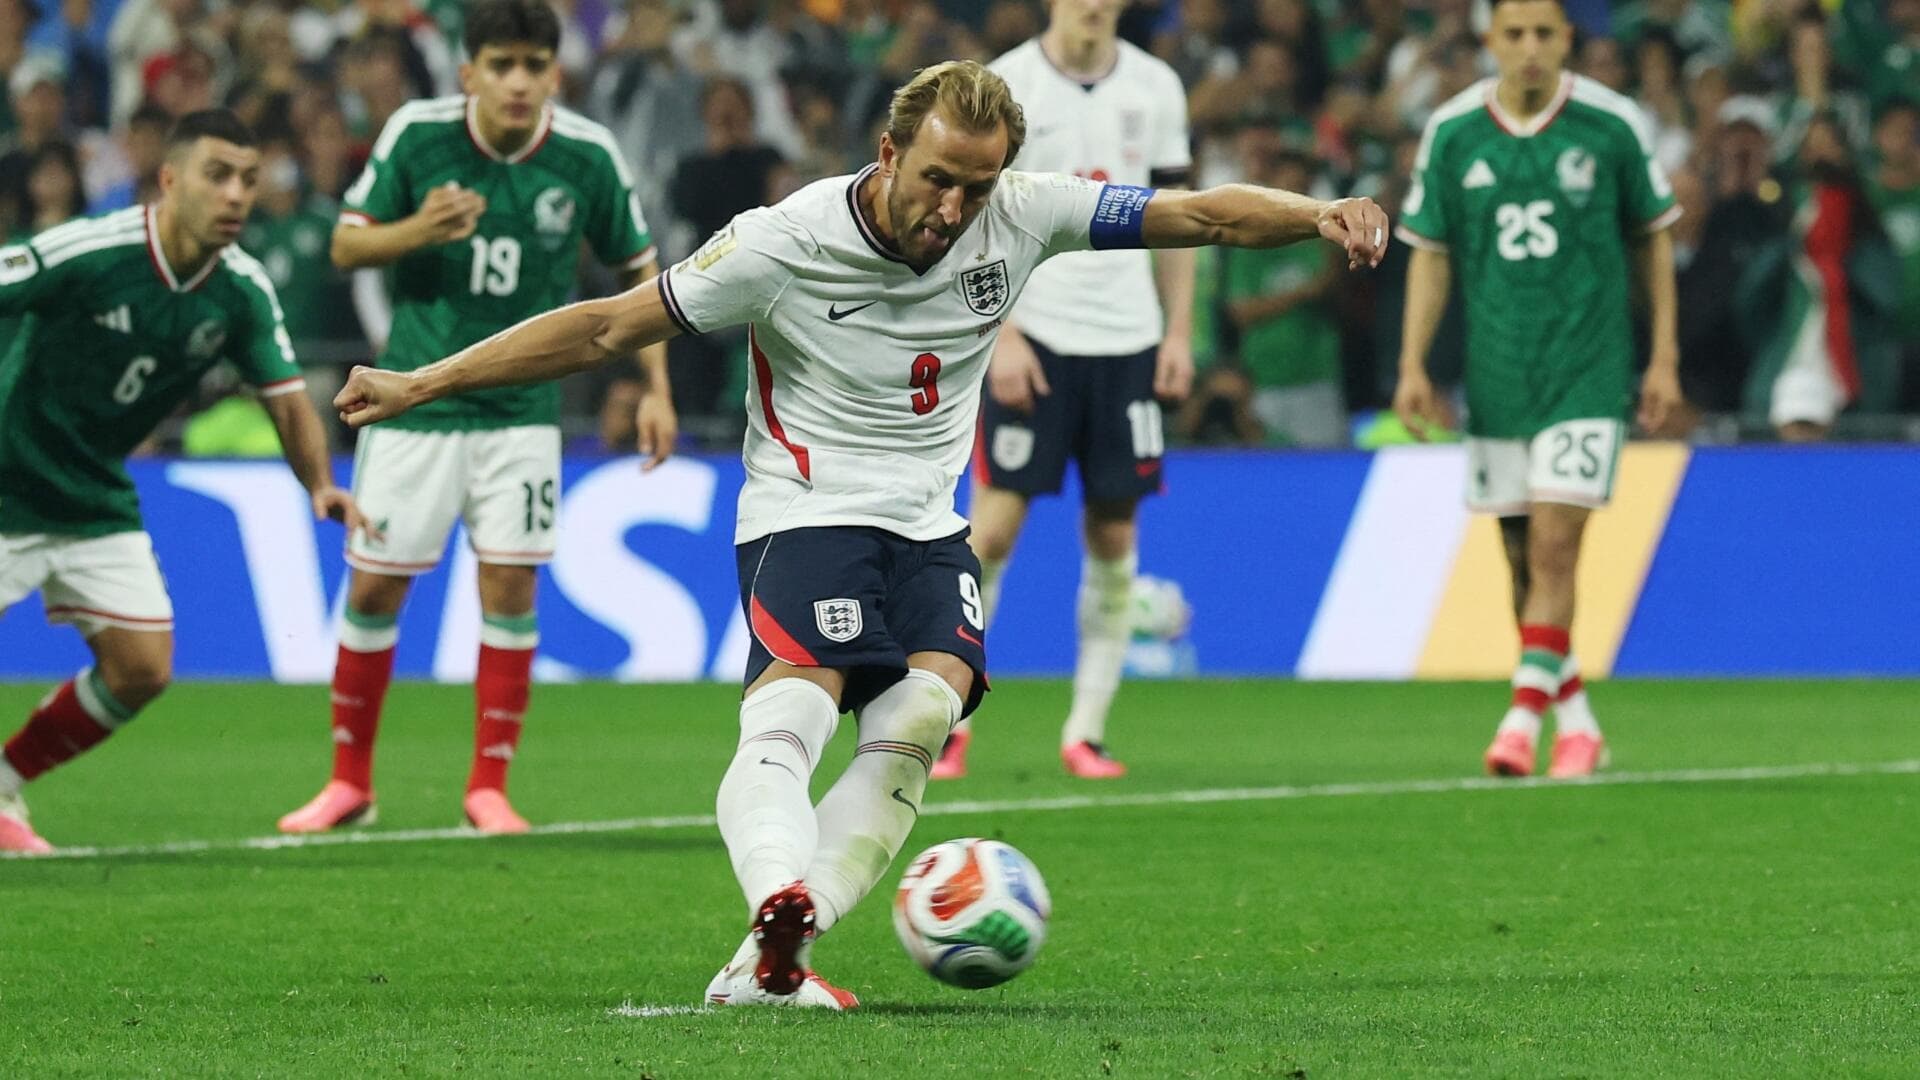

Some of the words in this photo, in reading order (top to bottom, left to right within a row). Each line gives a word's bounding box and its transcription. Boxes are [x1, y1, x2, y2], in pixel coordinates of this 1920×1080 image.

[1496, 199, 1559, 261] 25
[469, 234, 521, 296] 19
[113, 355, 157, 405] 6
[908, 351, 942, 416] 9
[1551, 430, 1600, 479] 25
[957, 571, 985, 632] 9
